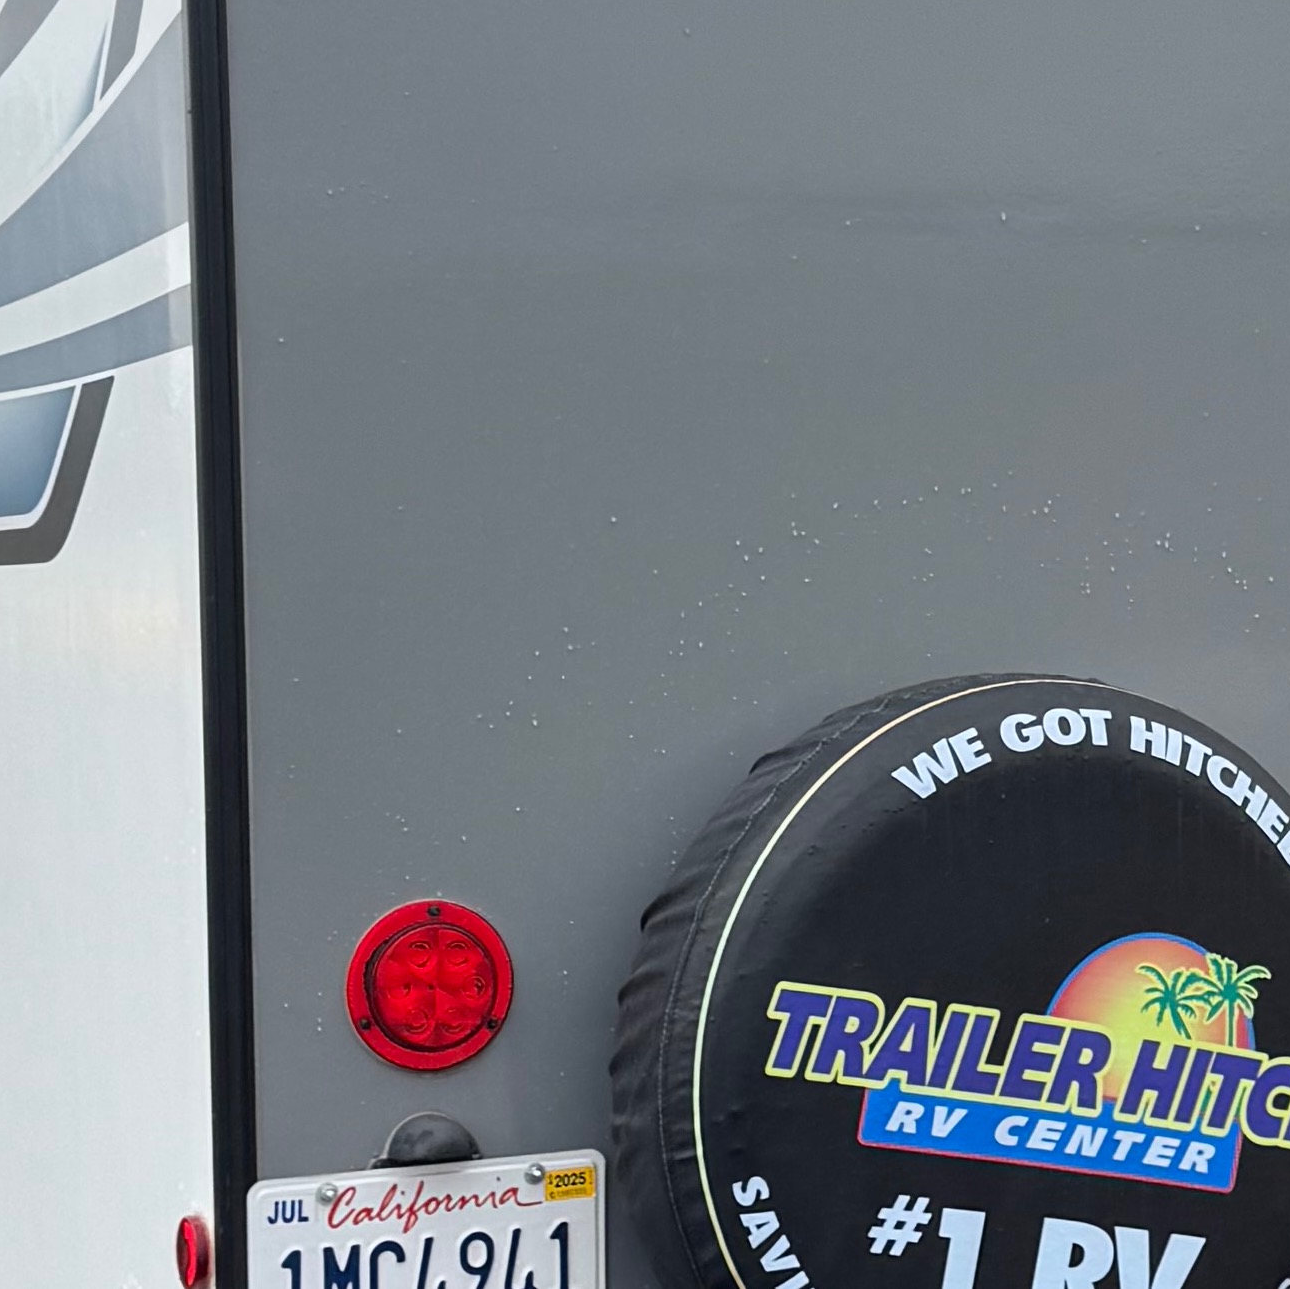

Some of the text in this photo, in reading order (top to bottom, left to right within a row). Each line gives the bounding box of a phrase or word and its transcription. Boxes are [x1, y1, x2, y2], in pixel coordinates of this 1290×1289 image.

[891, 727, 992, 799] WE
[1000, 708, 1112, 752] GOT
[764, 980, 1113, 1118] TRAILER
[885, 1101, 1217, 1175] RV CENTER
[267, 1199, 310, 1225] JUL
[327, 1181, 543, 1233] California
[554, 1171, 587, 1188] 2025
[732, 1176, 815, 1289] SAVI
[867, 1194, 1207, 1289] #1 RV
